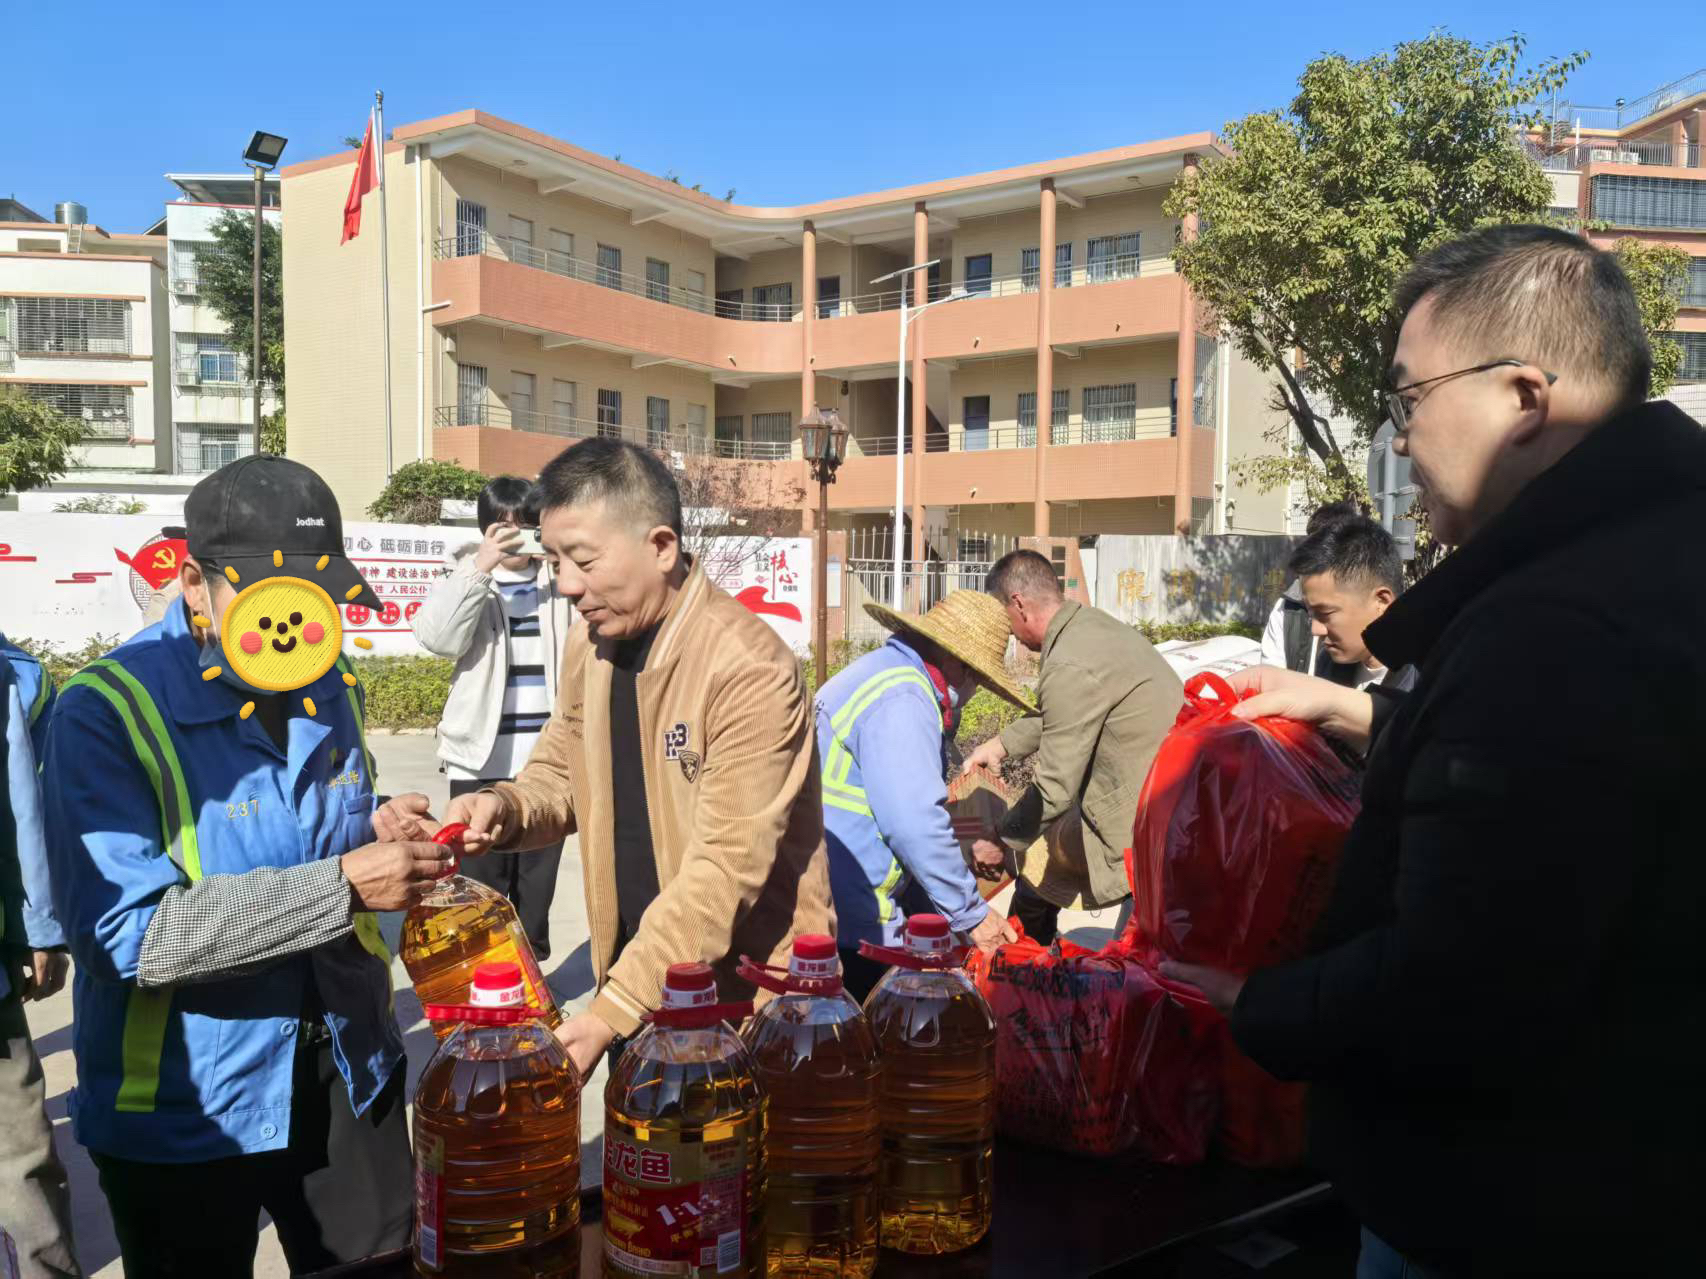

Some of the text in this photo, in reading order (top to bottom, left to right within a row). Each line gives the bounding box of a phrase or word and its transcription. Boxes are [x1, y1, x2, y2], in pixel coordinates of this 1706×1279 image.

[380, 537, 446, 556] 砥砺前行
[226, 799, 260, 820] 237
